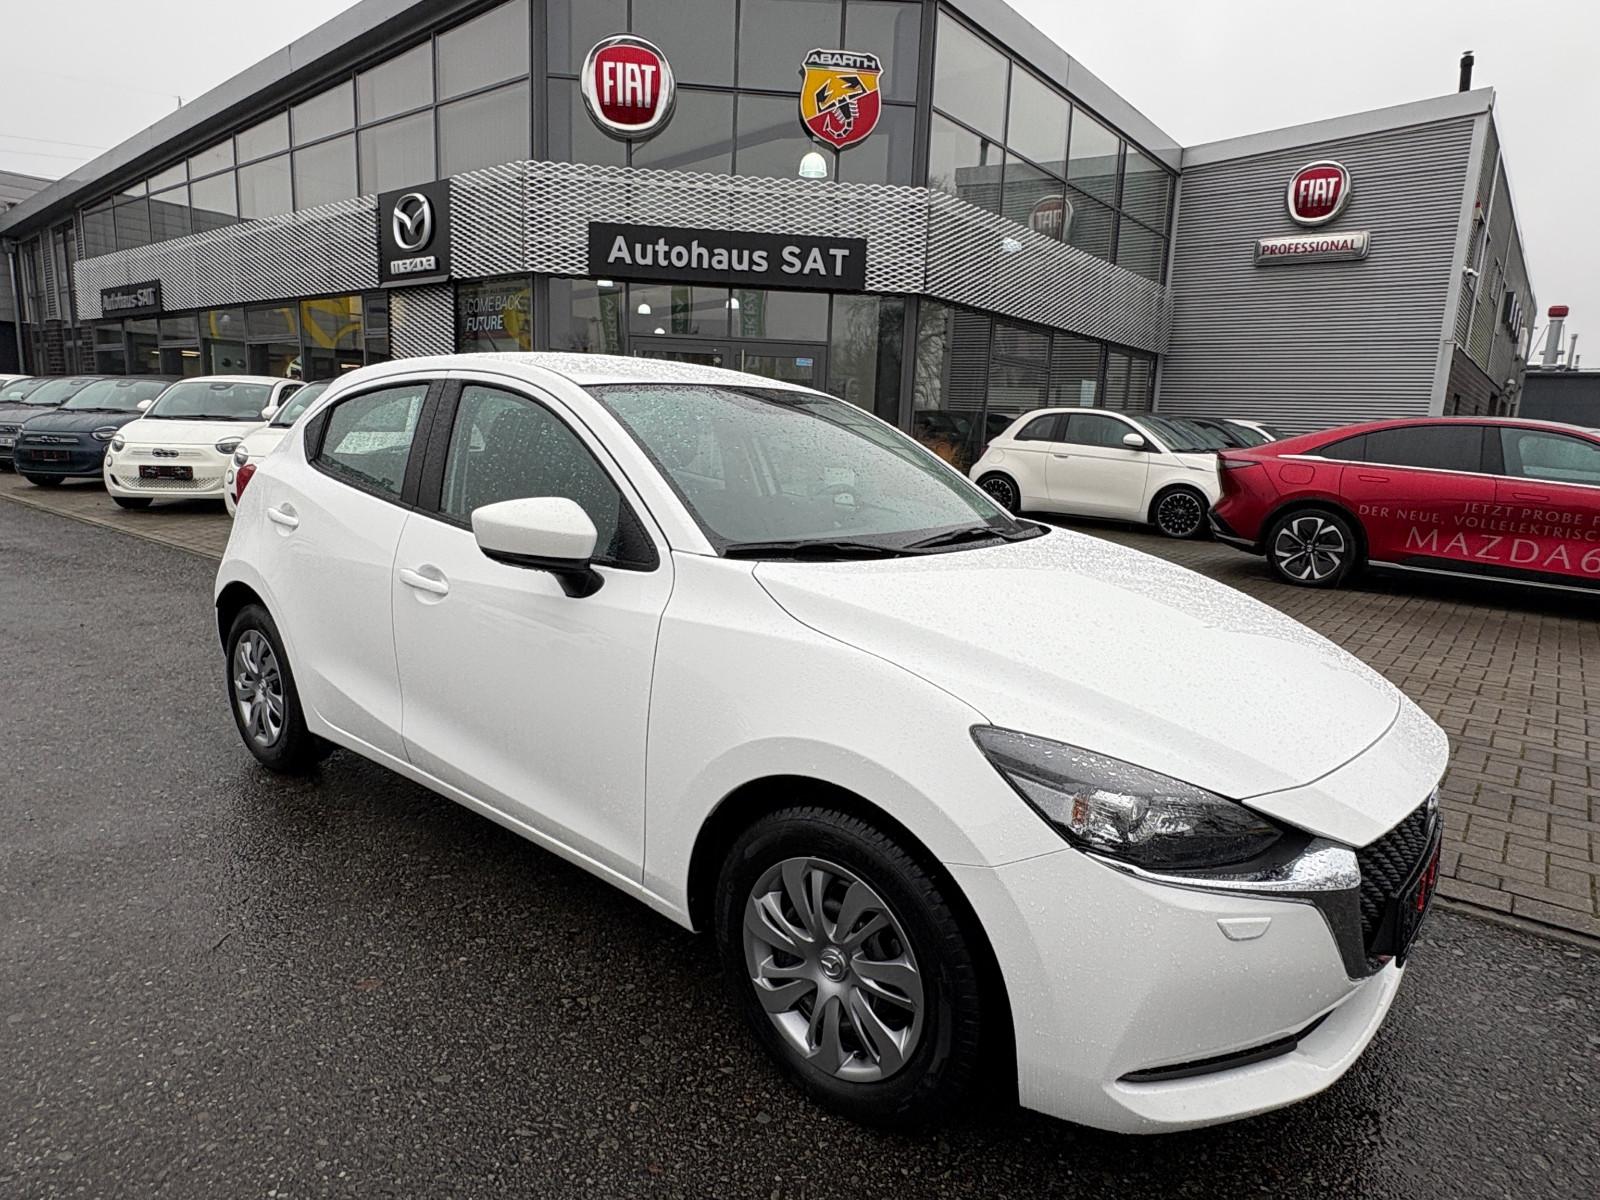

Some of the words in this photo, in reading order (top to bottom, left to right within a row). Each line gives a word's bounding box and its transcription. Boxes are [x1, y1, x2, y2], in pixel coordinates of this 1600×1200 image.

[808, 53, 876, 69] ABARTH
[602, 61, 656, 108] FIAT
[1298, 177, 1339, 208] FIAT
[607, 235, 768, 272] Autohaus
[781, 245, 850, 276] SAT
[1261, 239, 1356, 256] PROFESSIONAL
[1358, 504, 1389, 518] DER
[1454, 515, 1600, 542] VOLLELEKTRISC
[1463, 502, 1514, 518] JETZT
[1520, 508, 1583, 526] PROBE
